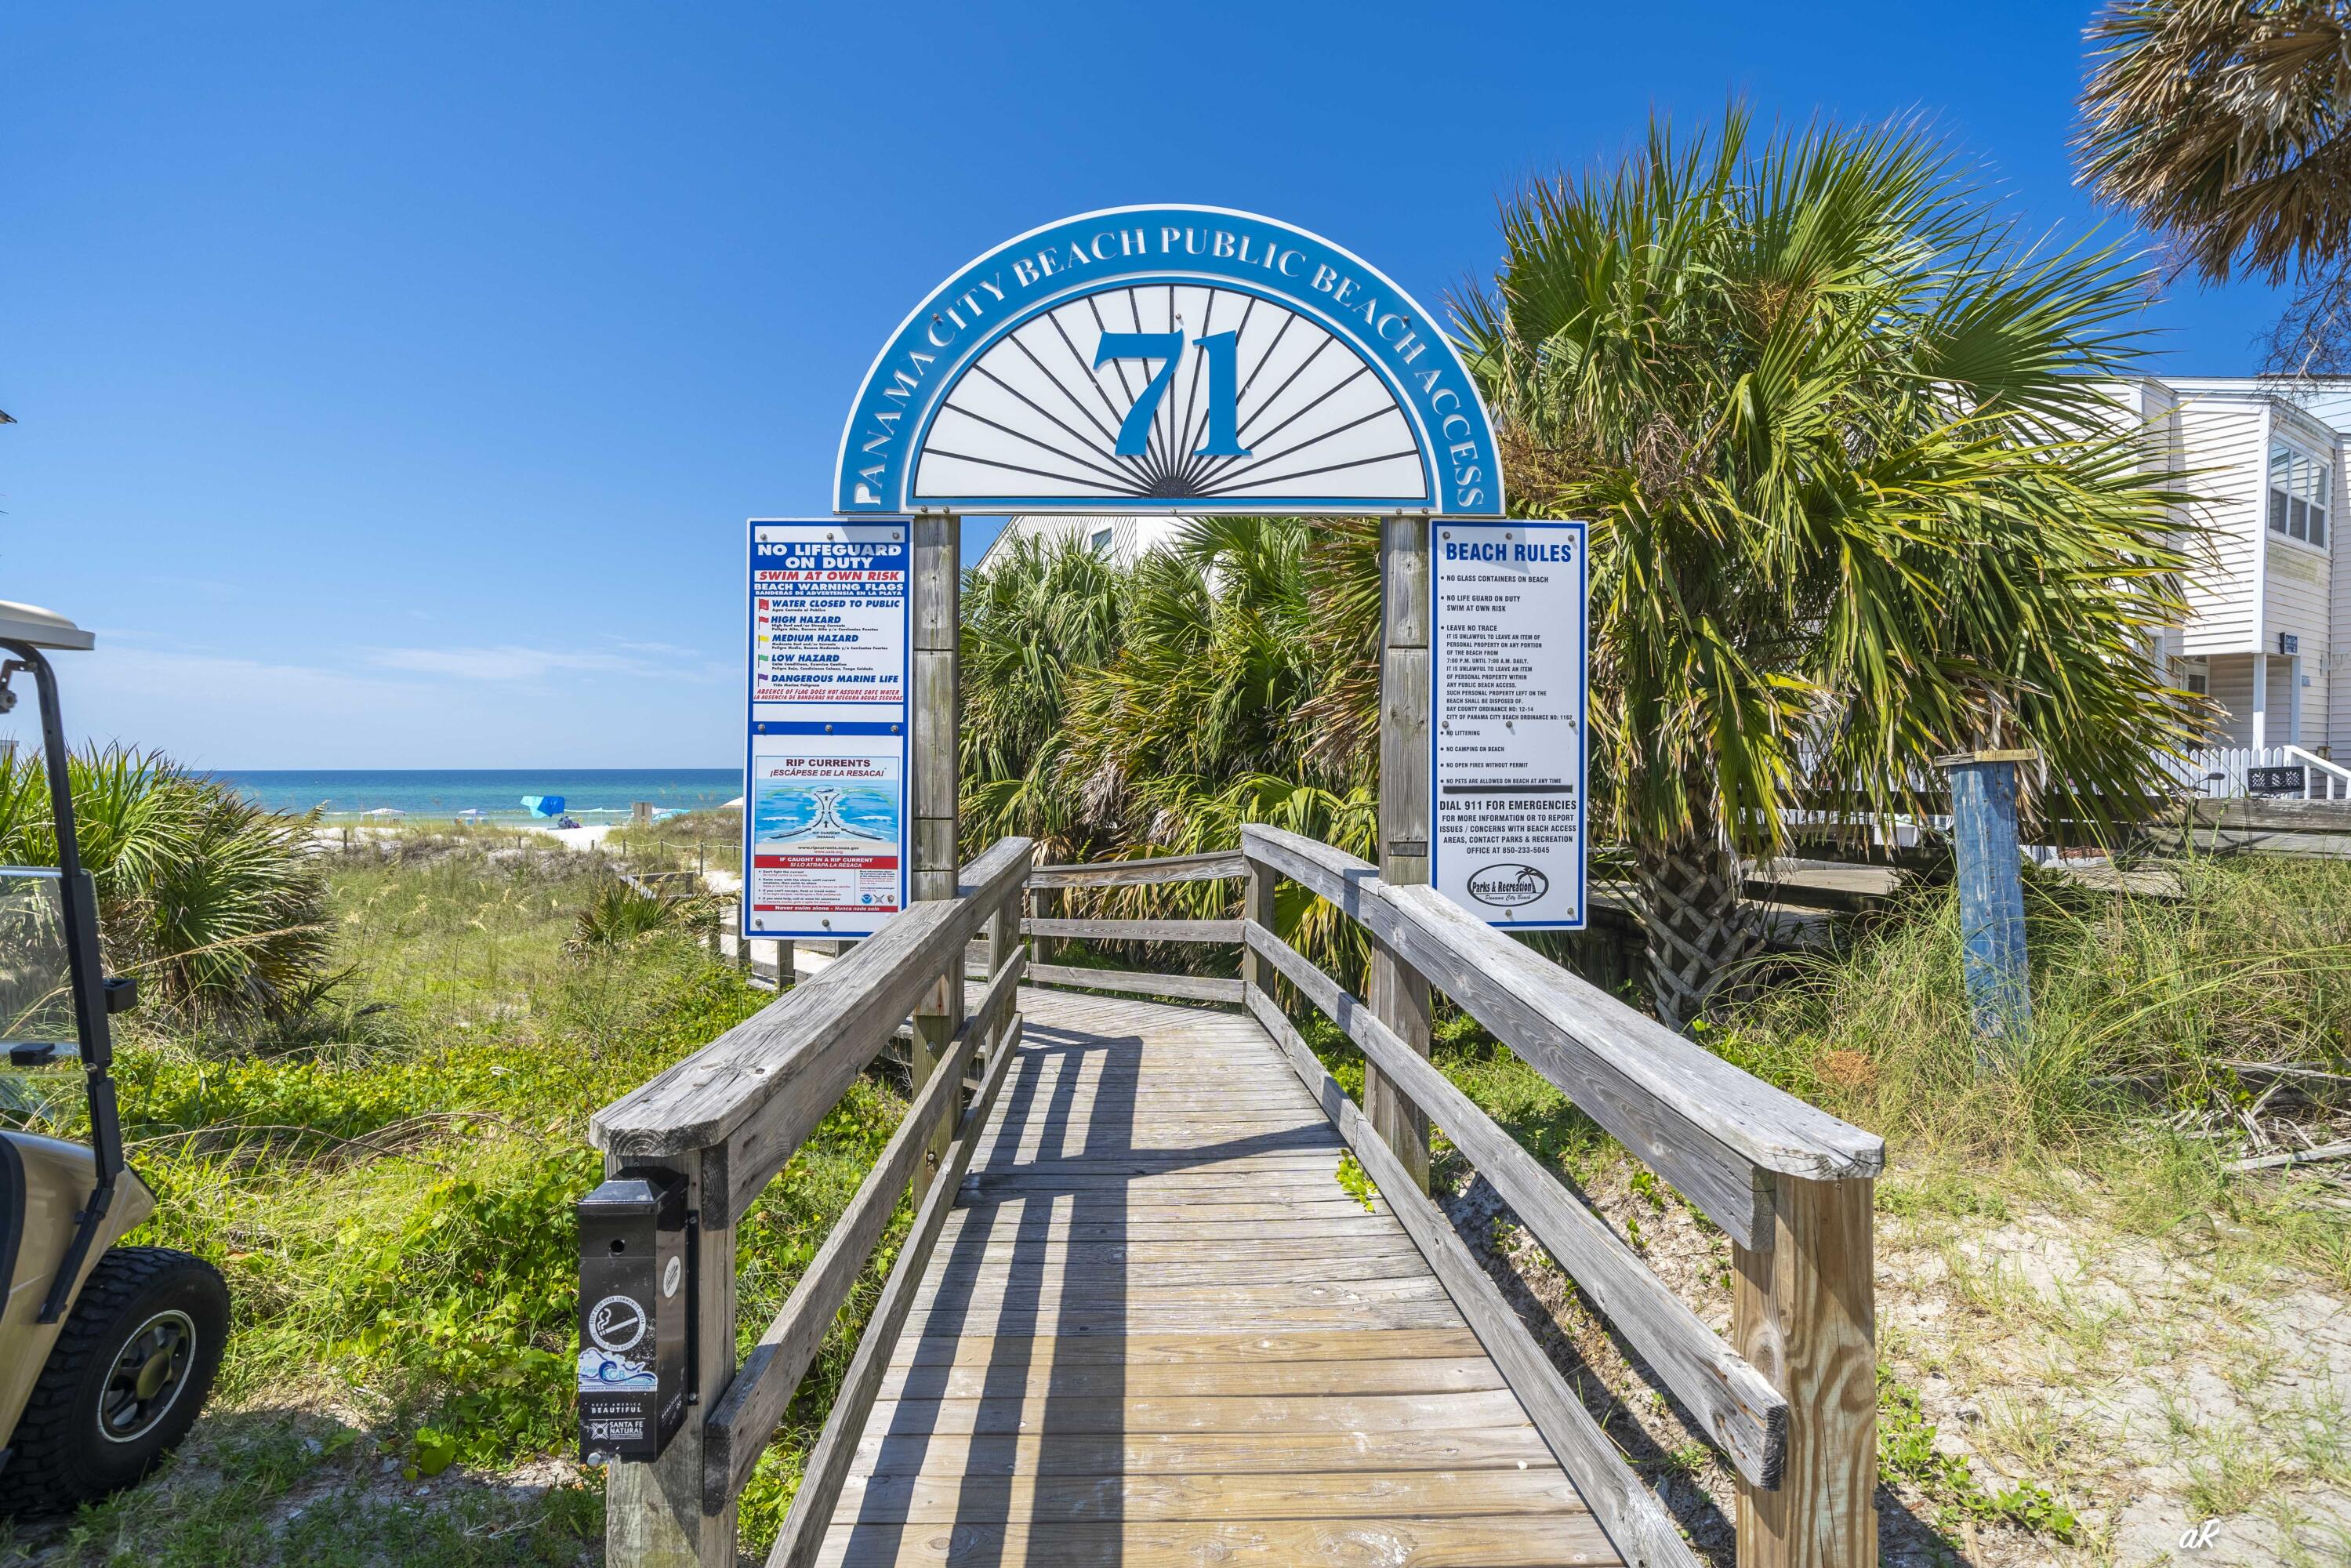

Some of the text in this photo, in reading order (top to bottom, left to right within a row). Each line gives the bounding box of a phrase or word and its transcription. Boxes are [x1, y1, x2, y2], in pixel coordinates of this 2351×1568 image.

[854, 227, 1483, 506] PANAMA CITY BEACH PUBLIC BEACH ACCESS
[1092, 328, 1253, 459] 71
[758, 544, 902, 556] NO LIFEGUARD
[1446, 543, 1571, 561] BEACH RULES
[785, 557, 873, 568] ON DUTY
[759, 572, 899, 580] SWIM AT OWN RISK
[771, 768, 818, 777] ¡ESCÁPESE
[1440, 800, 1576, 811] DIAL 911 FOR EMERGENCIES
[1472, 882, 1531, 893] Parks & Recreation
